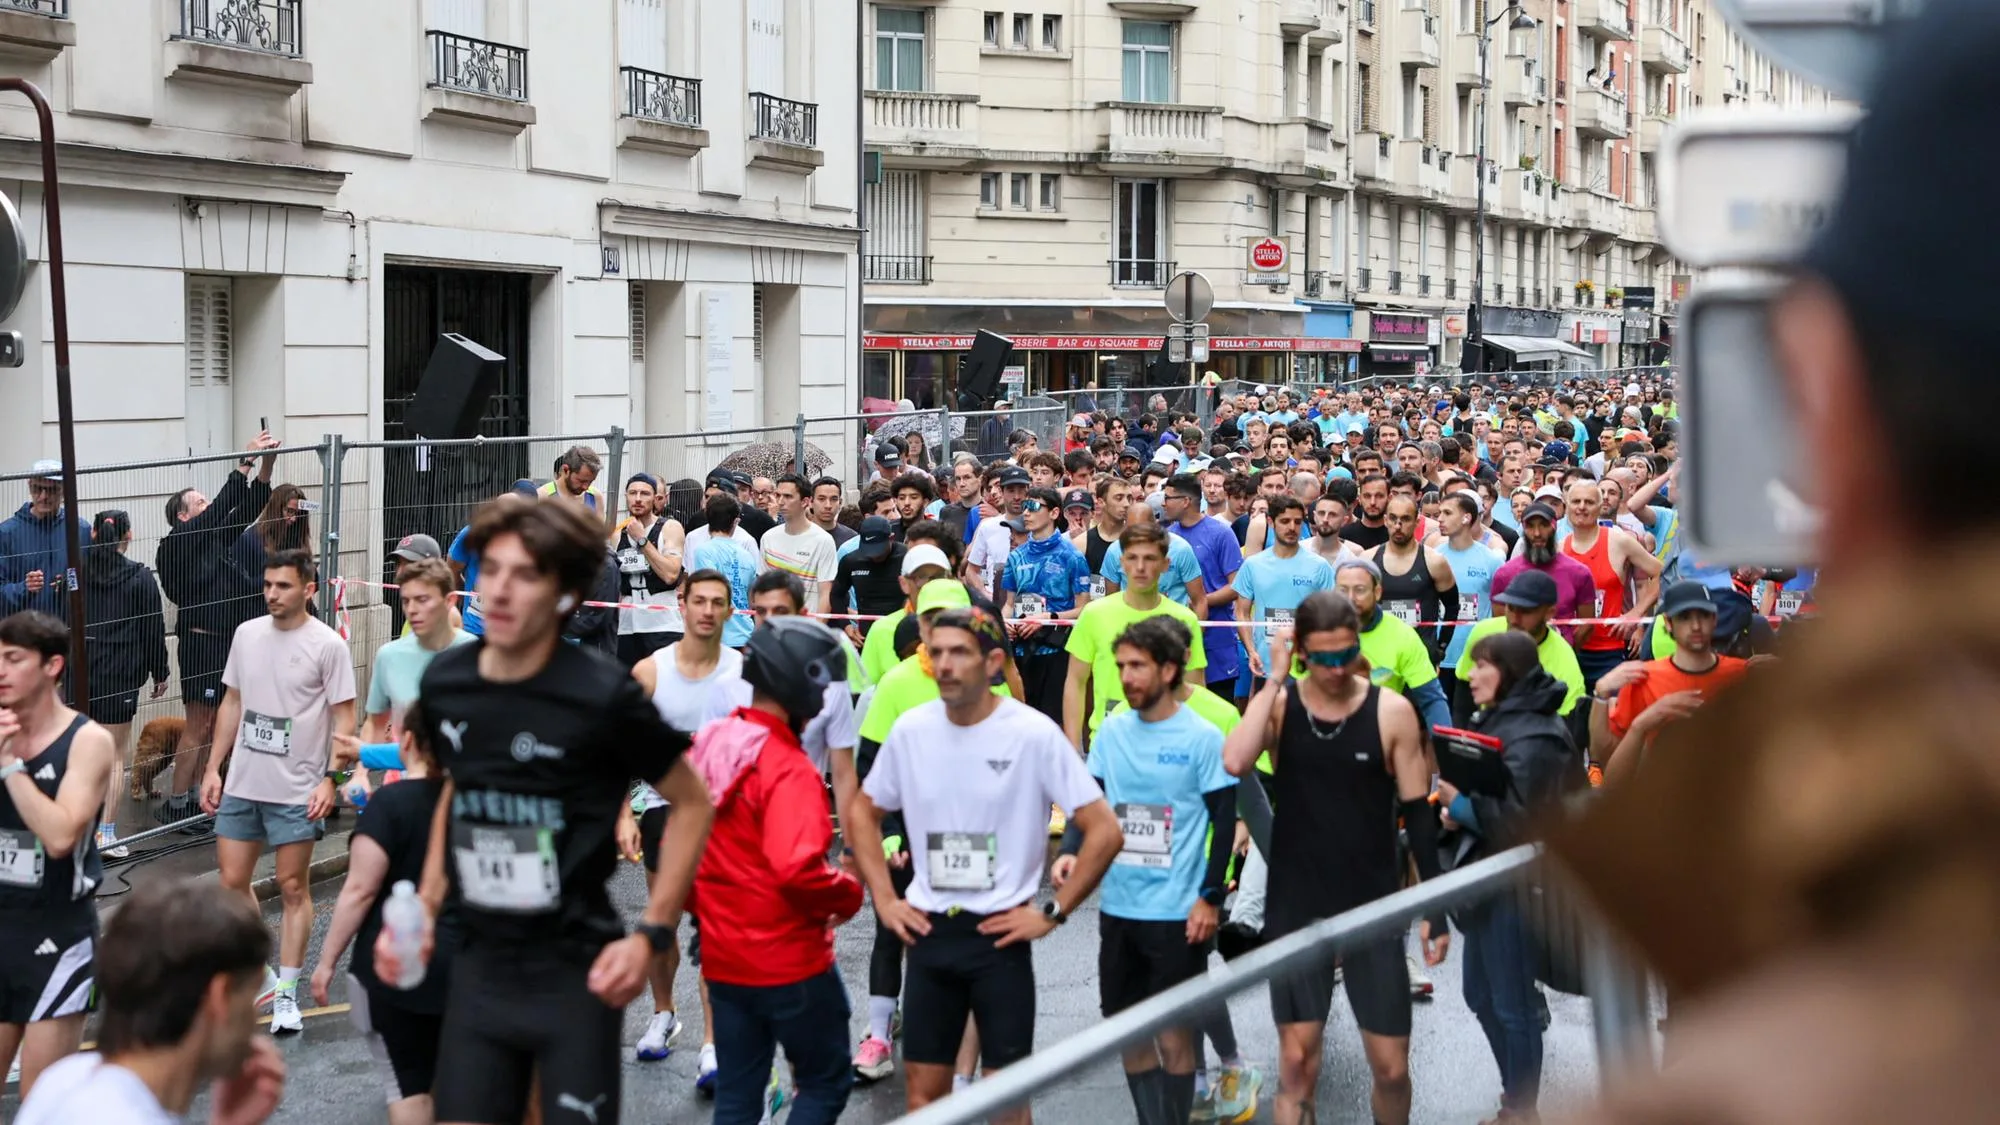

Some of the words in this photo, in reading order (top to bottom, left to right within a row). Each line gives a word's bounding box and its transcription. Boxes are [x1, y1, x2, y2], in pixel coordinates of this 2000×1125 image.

[604, 249, 619, 271] 190
[903, 338, 934, 347] STELLA
[954, 339, 975, 347] ARTO
[1013, 338, 1048, 347] SSERIE
[1057, 338, 1078, 347] BAR
[1082, 338, 1096, 347] du
[1098, 338, 1139, 347] SQUARE
[1215, 340, 1244, 348] STELLA
[1262, 340, 1292, 349] ARTOIS
[623, 556, 639, 565] 396
[1021, 603, 1036, 613] 606
[255, 727, 273, 741] 103
[1121, 821, 1156, 837] 8220
[943, 853, 971, 869] 128
